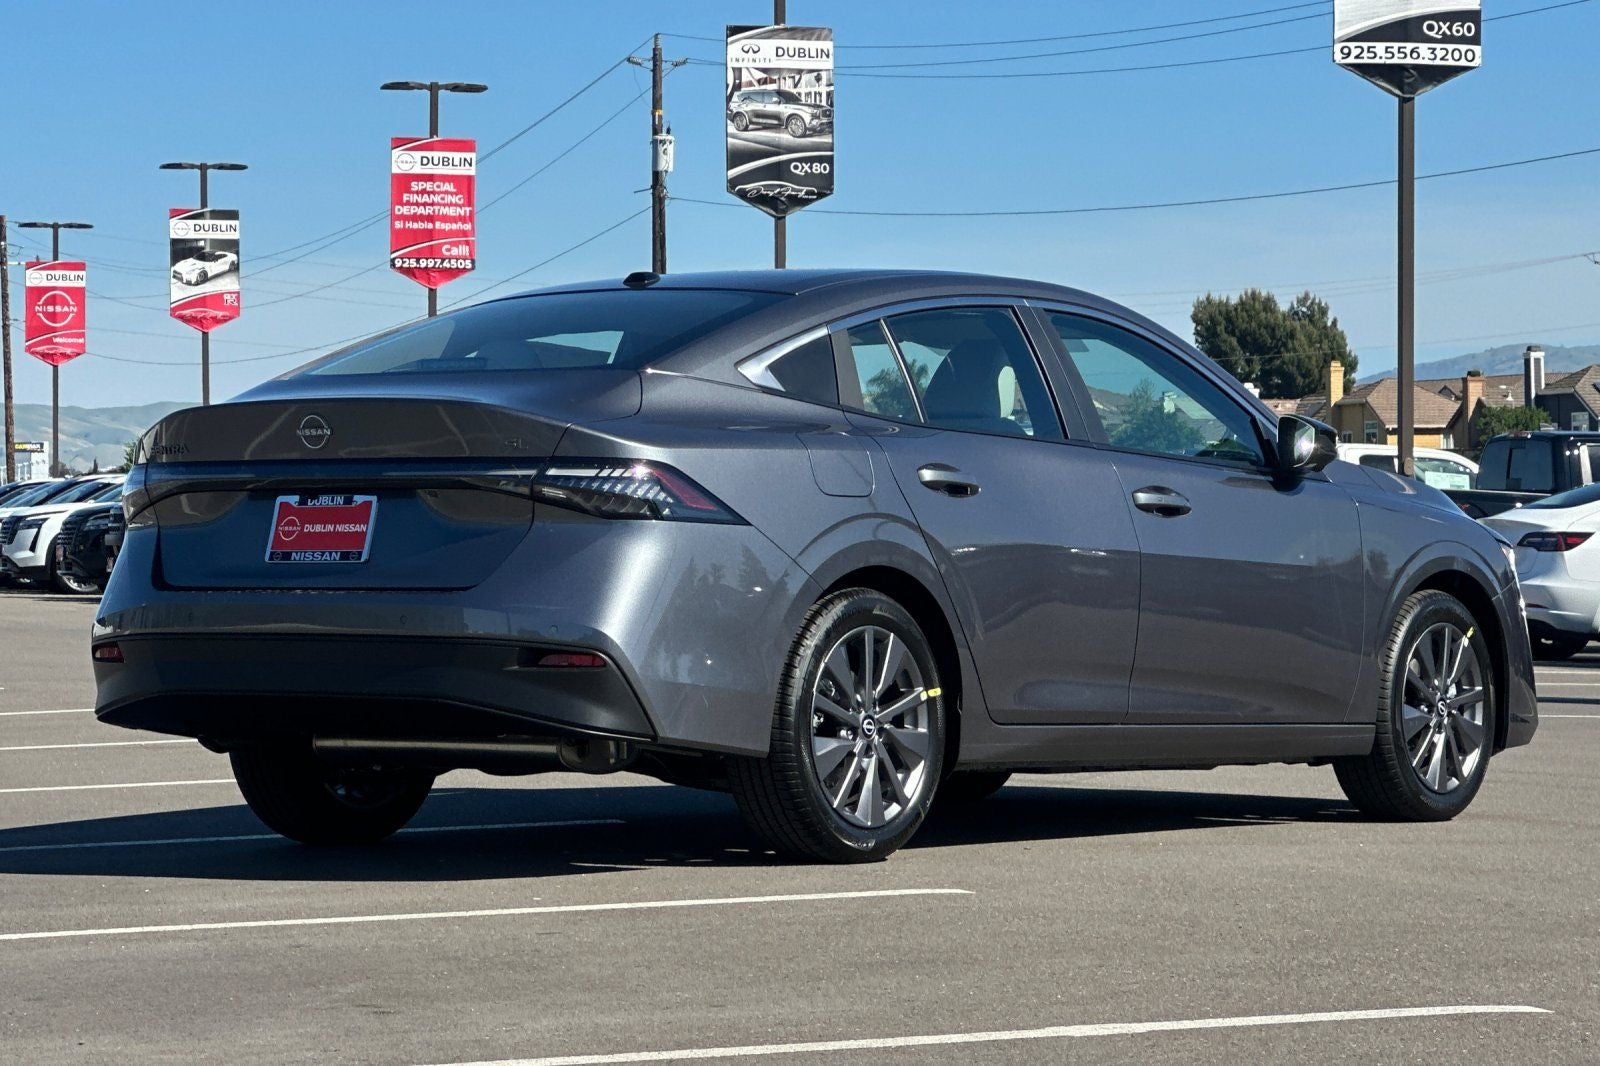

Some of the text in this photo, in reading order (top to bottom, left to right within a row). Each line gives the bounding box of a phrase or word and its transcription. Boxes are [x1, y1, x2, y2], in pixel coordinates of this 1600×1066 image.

[1423, 20, 1475, 39] QX60
[775, 46, 830, 59] DUBLIN
[1340, 45, 1476, 63] 925.556.3200
[420, 156, 473, 168] DUBLIN
[790, 162, 830, 176] QX80
[410, 181, 457, 192] SPECIAL
[402, 193, 464, 204] FINANCING
[395, 205, 472, 217] DEPARTMENT
[193, 223, 237, 233] DUBLIN
[405, 221, 433, 229] Habla
[435, 221, 472, 231] Español
[441, 244, 470, 256] Call!
[394, 258, 472, 268] 925.997.4505
[46, 273, 84, 282] DUBLIN
[35, 305, 77, 313] NISSAN
[307, 496, 344, 506] DUBLIN
[303, 524, 367, 533] DUBLIN NISSAN
[290, 551, 341, 561] NISSAN
